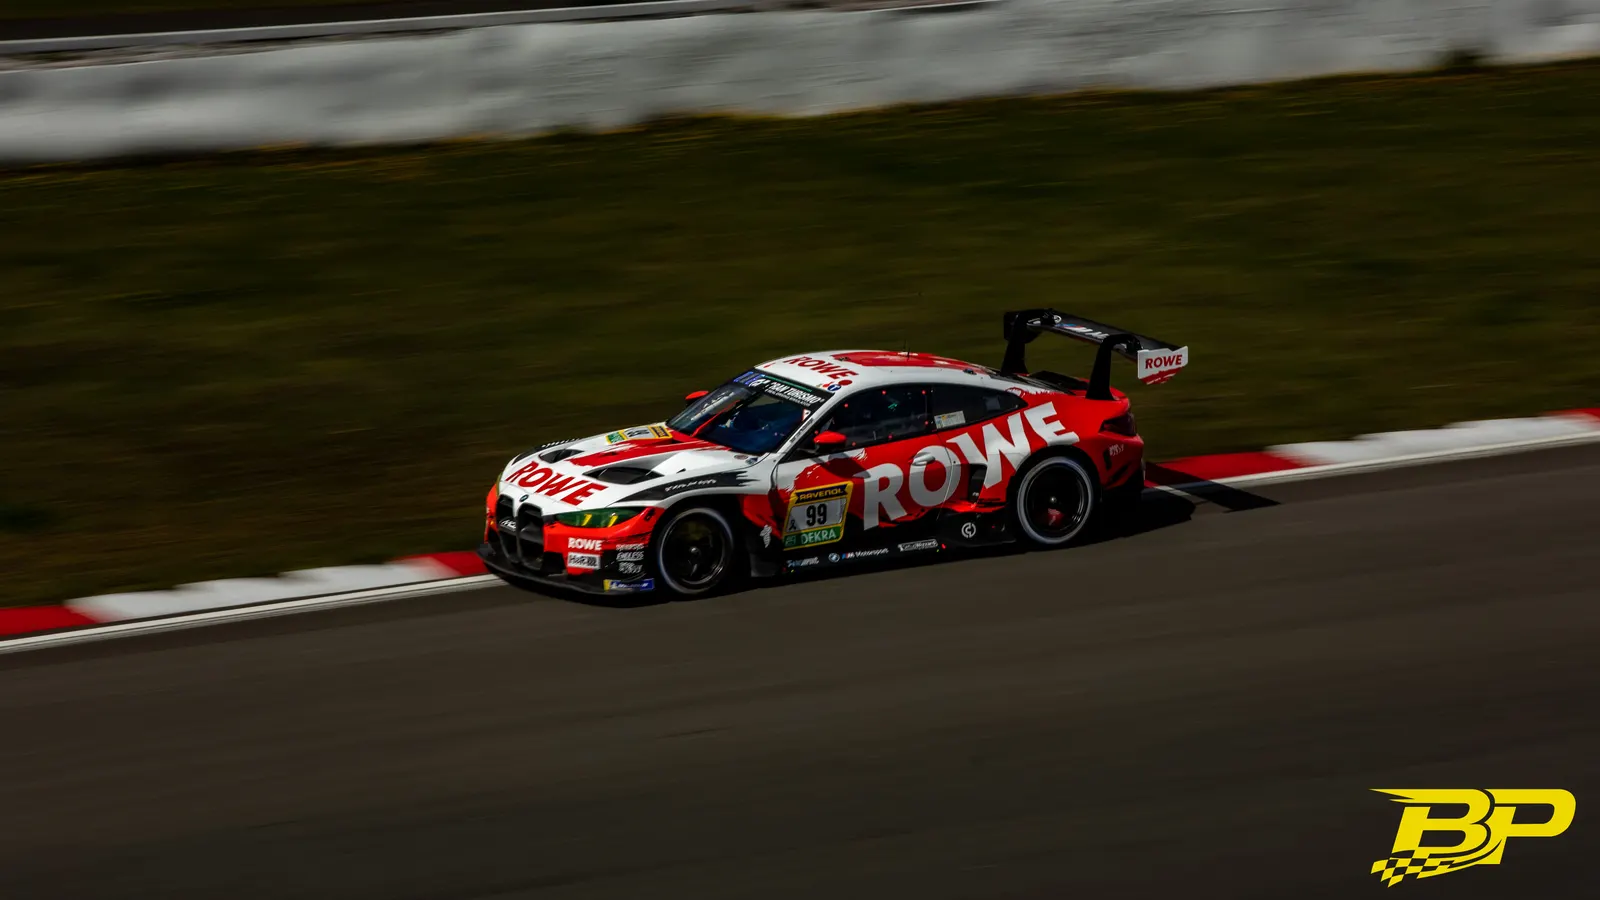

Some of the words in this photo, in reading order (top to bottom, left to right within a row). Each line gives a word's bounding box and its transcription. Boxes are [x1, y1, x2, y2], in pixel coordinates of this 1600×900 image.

[783, 356, 860, 380] ROWE
[1145, 354, 1183, 369] ROWE
[852, 401, 1080, 531] ROWE
[505, 460, 610, 507] ROWE
[800, 487, 844, 500] RAVENOL
[806, 503, 828, 527] 99
[568, 537, 603, 551] ROWE
[801, 528, 837, 545] DEKRA
